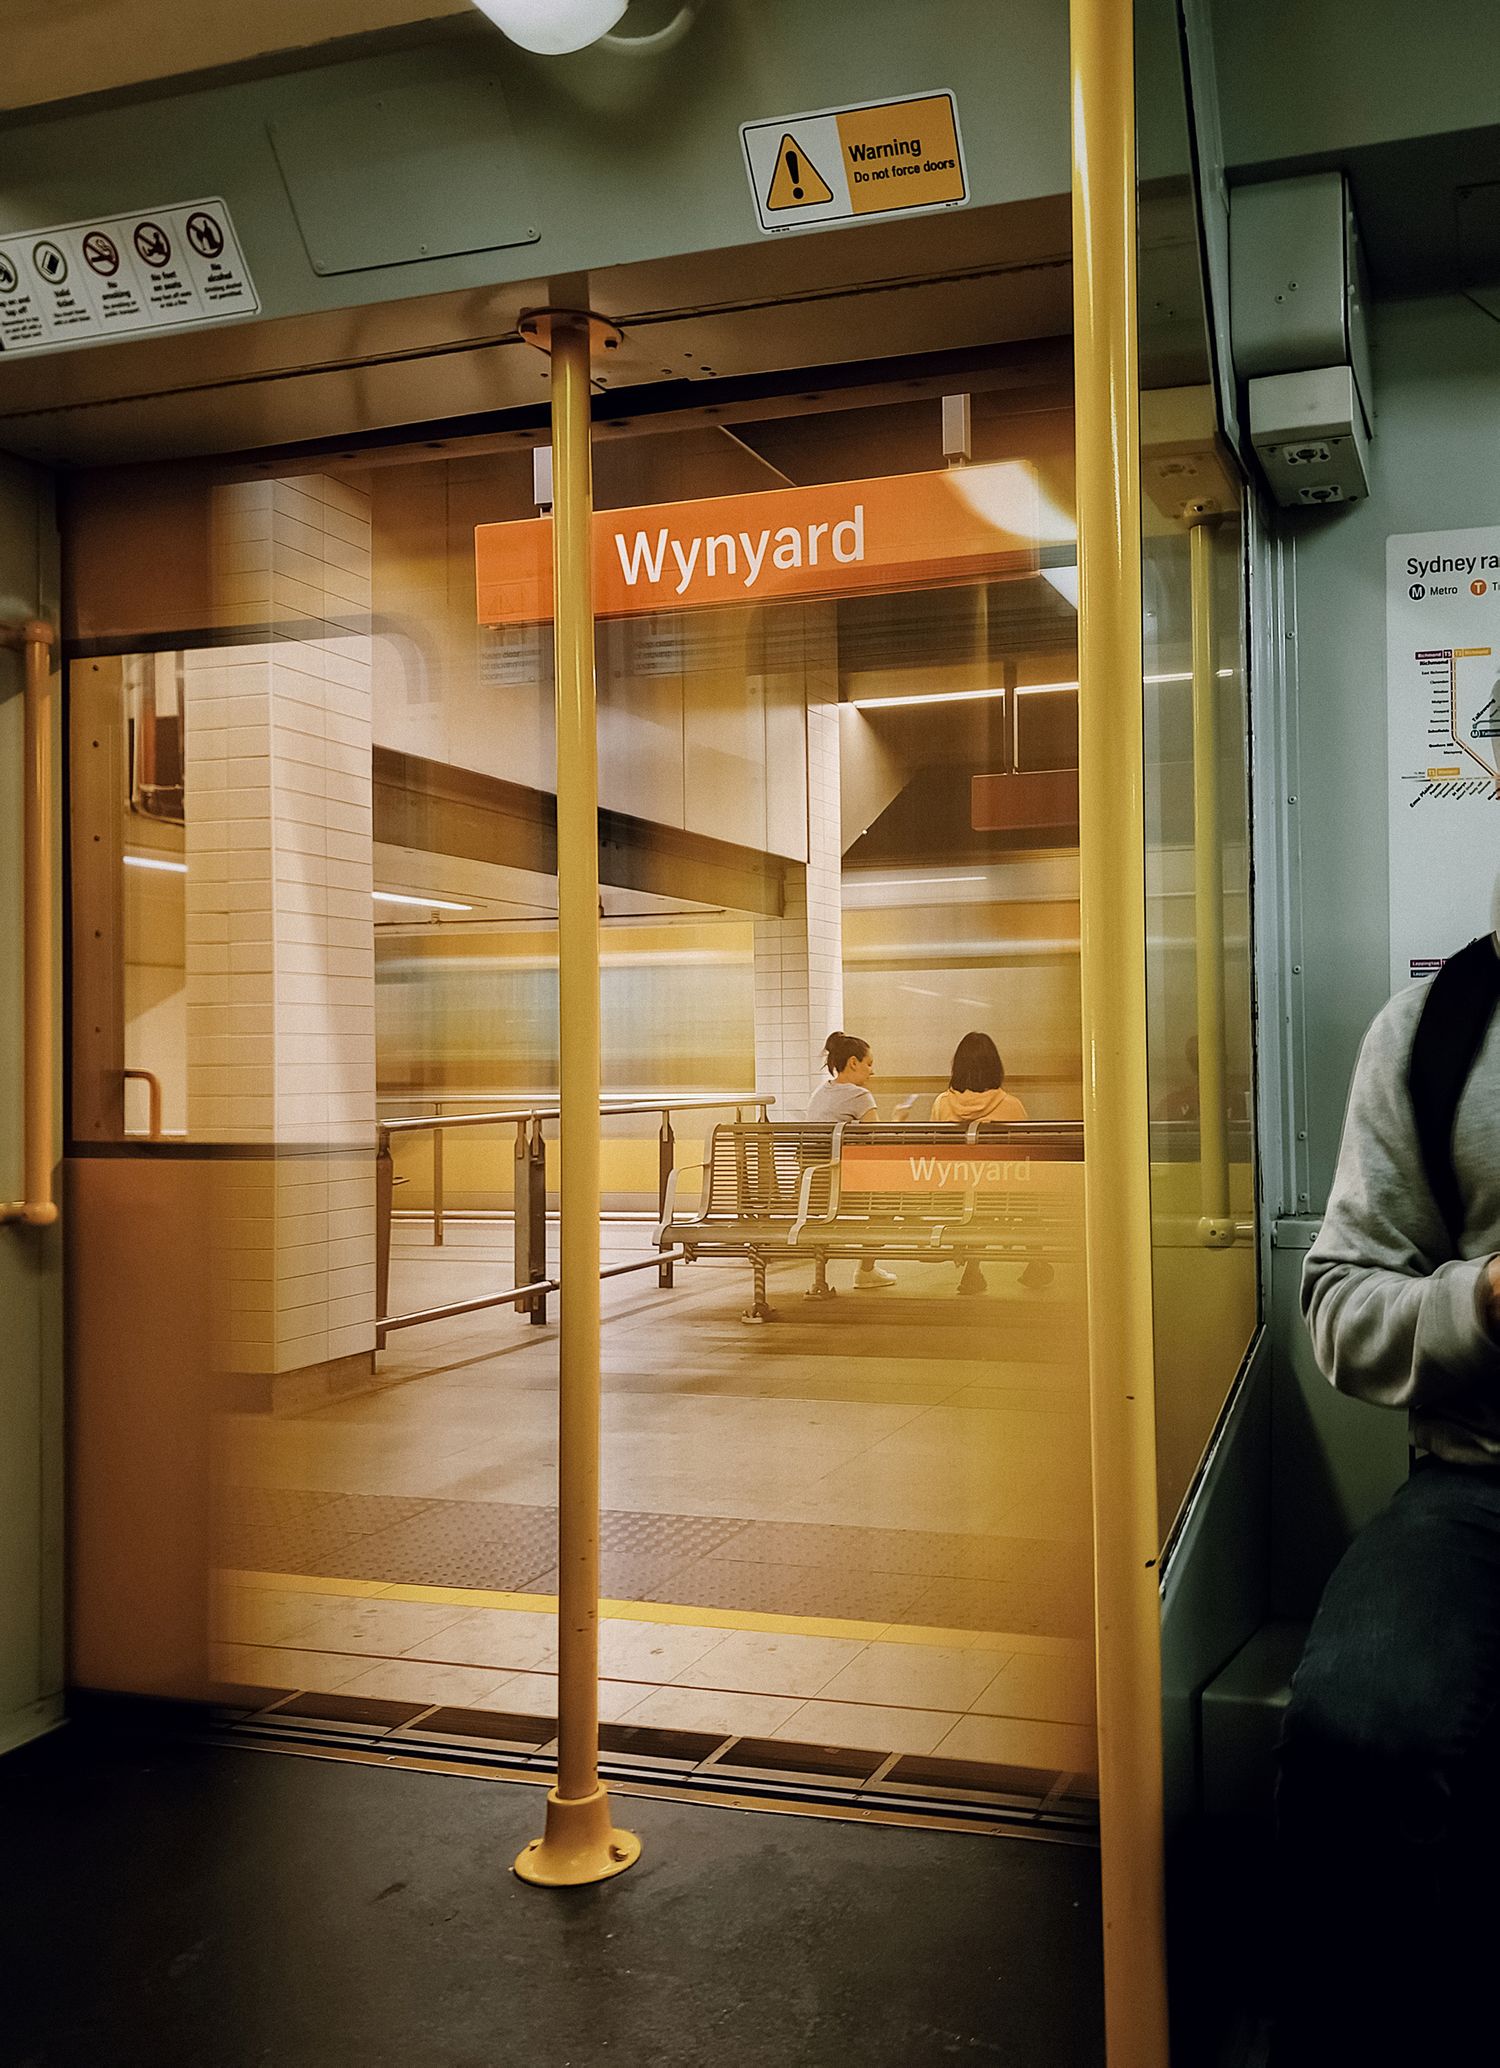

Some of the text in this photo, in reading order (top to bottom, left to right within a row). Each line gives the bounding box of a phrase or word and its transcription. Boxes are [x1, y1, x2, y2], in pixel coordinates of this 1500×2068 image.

[848, 139, 921, 163] Warning
[853, 159, 955, 183] Do not force doors
[614, 504, 865, 596] Wynyard
[1407, 555, 1477, 578] Sydney
[1430, 586, 1458, 596] Metro
[909, 1155, 1031, 1188] Wynyard
